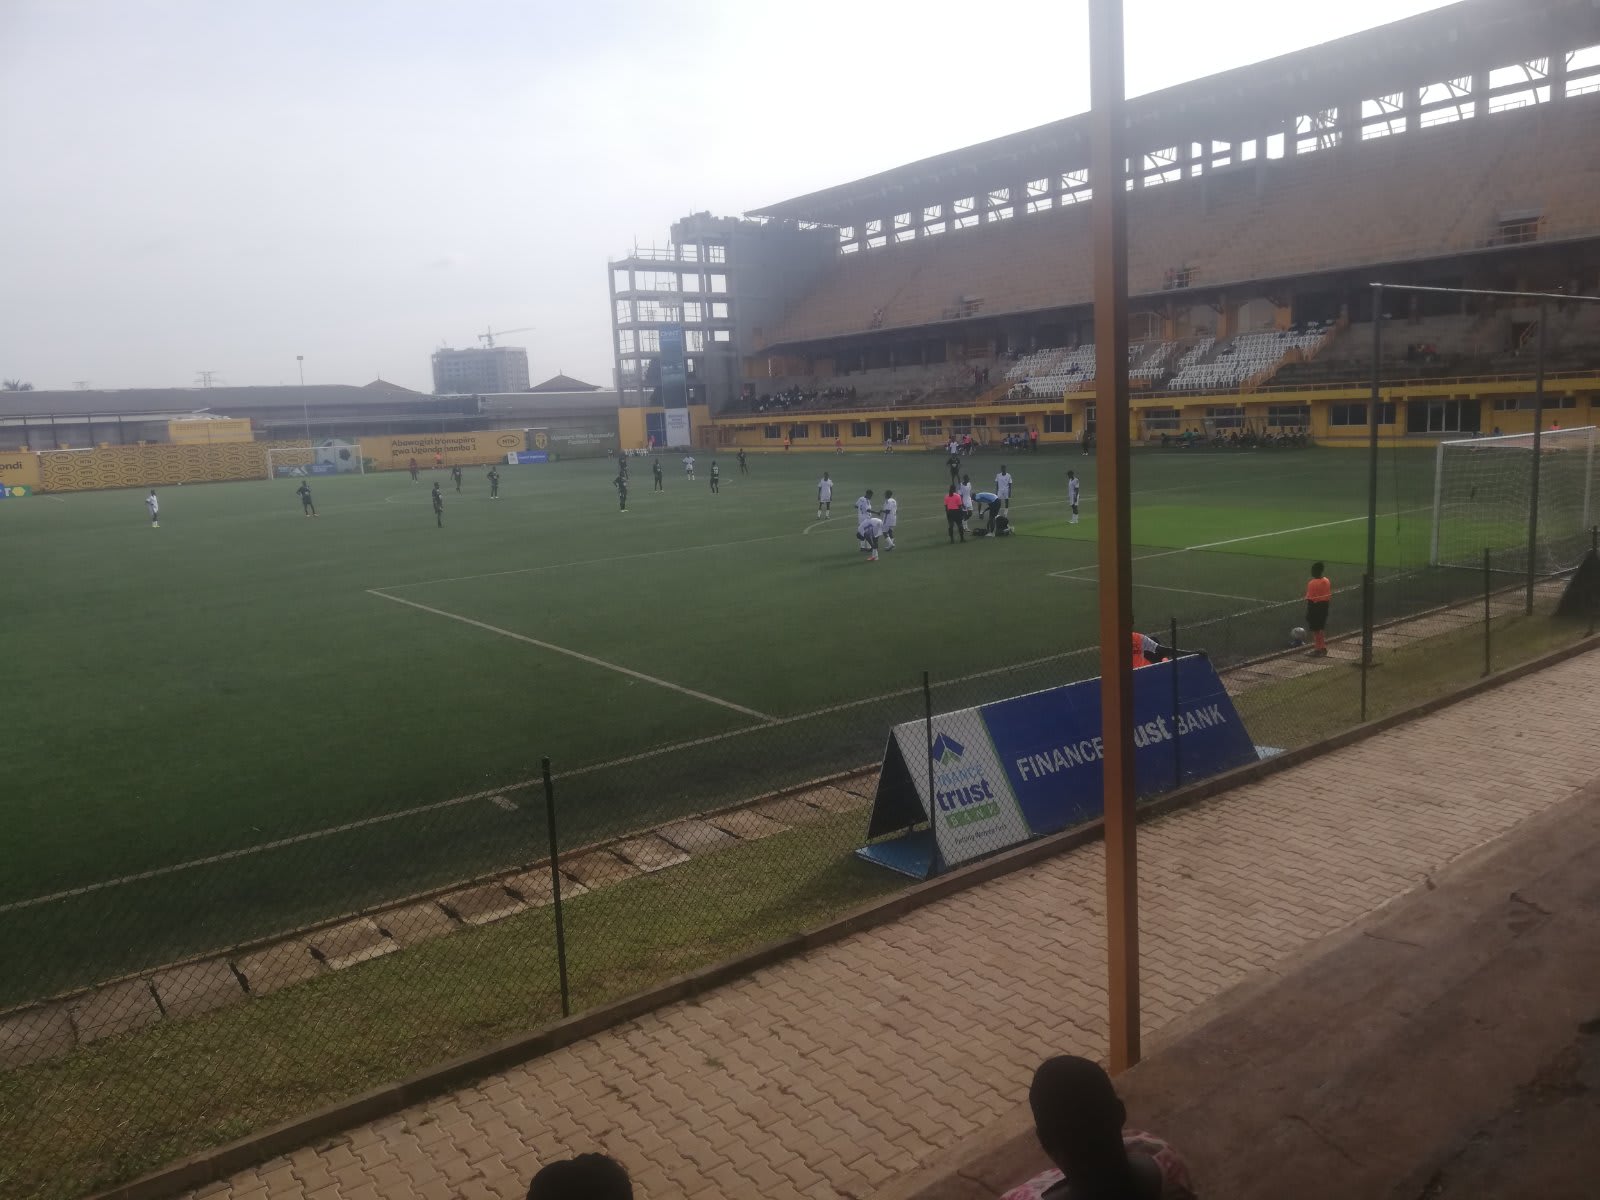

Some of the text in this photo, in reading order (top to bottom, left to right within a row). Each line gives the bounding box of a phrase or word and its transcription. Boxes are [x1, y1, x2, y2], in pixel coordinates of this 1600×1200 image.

[392, 447, 410, 456] gwa
[412, 445, 442, 455] Uganda
[1016, 704, 1226, 782] FINANCE ust BANK
[937, 778, 994, 812] trust
[950, 803, 996, 827] BANK
